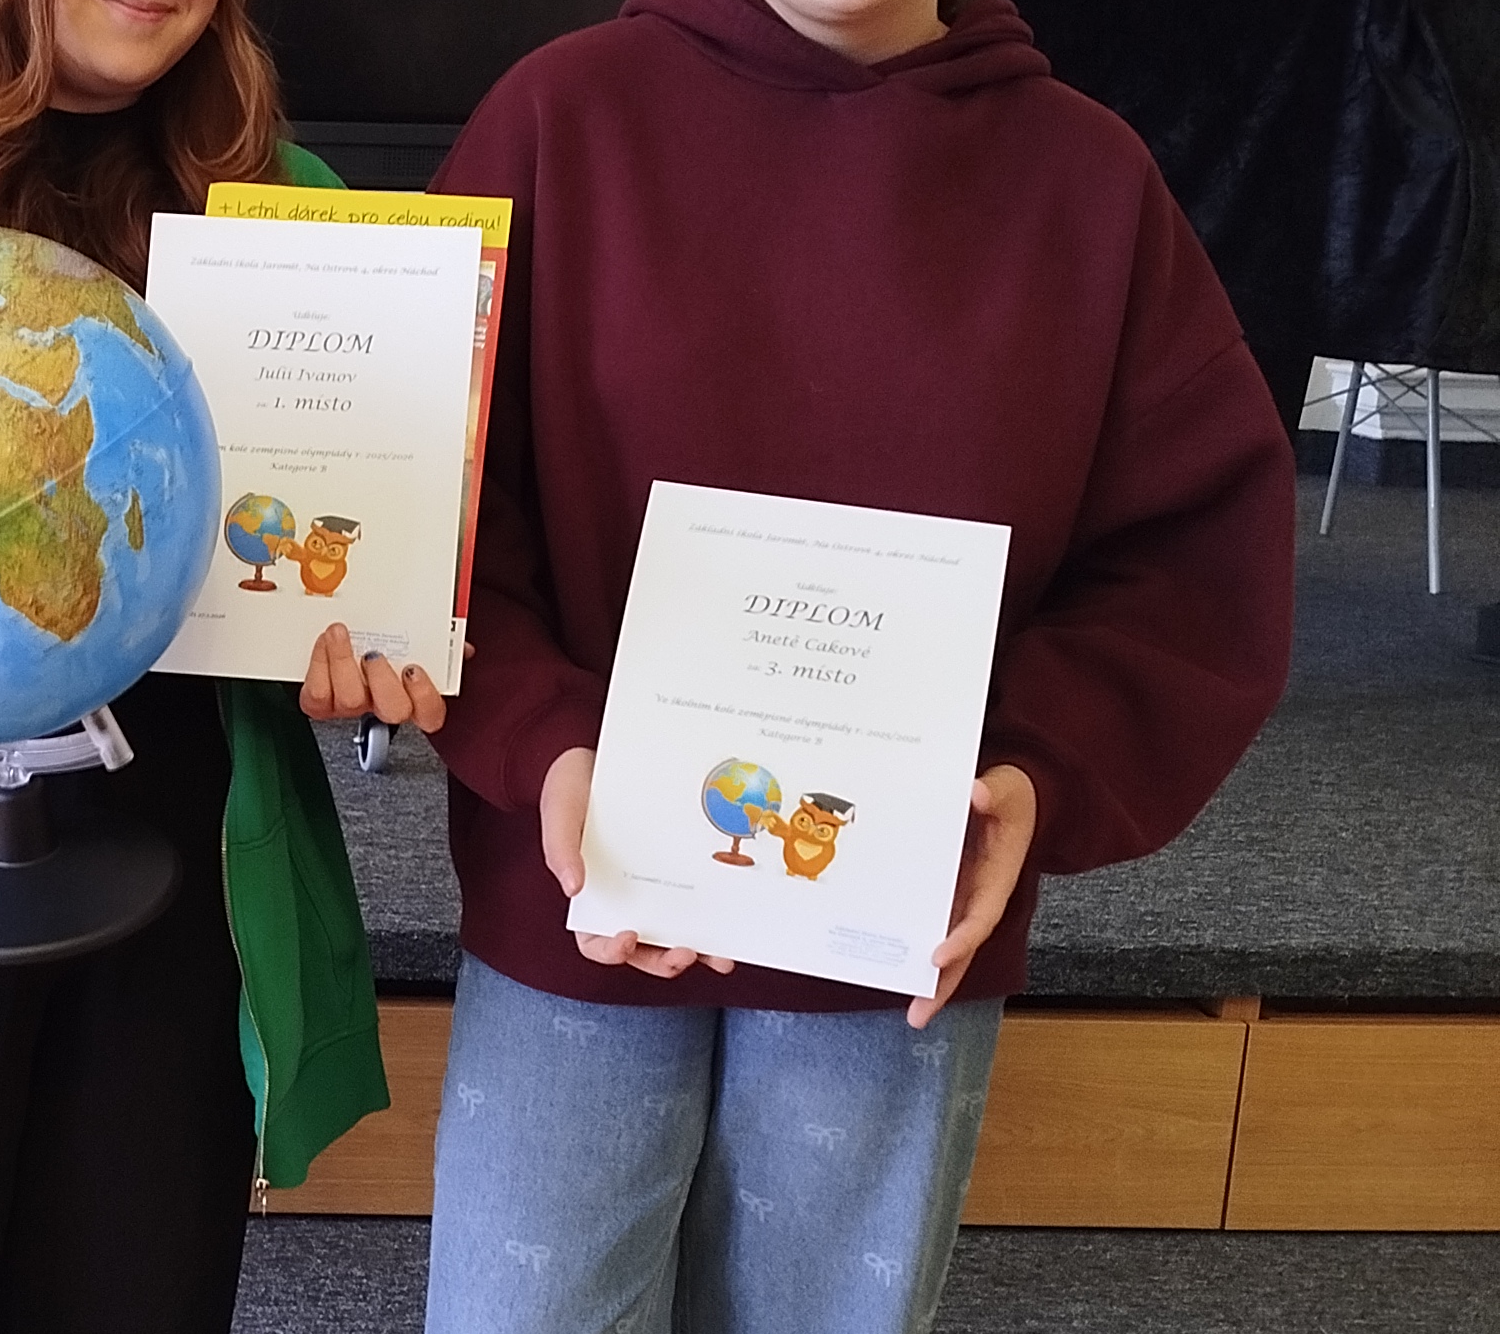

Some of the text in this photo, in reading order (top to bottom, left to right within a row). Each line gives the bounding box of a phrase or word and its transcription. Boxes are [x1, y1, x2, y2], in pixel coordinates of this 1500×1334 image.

[287, 203, 340, 223] dárek
[387, 209, 431, 226] celou
[247, 328, 374, 355] DIPLOM
[296, 367, 357, 383] Ivanov
[294, 393, 353, 412] místo
[269, 461, 318, 473] Kategorie
[743, 594, 884, 631] DIPLOM
[743, 629, 871, 659] Anetě Cakové
[764, 660, 782, 676] 3.
[792, 663, 857, 685] místo
